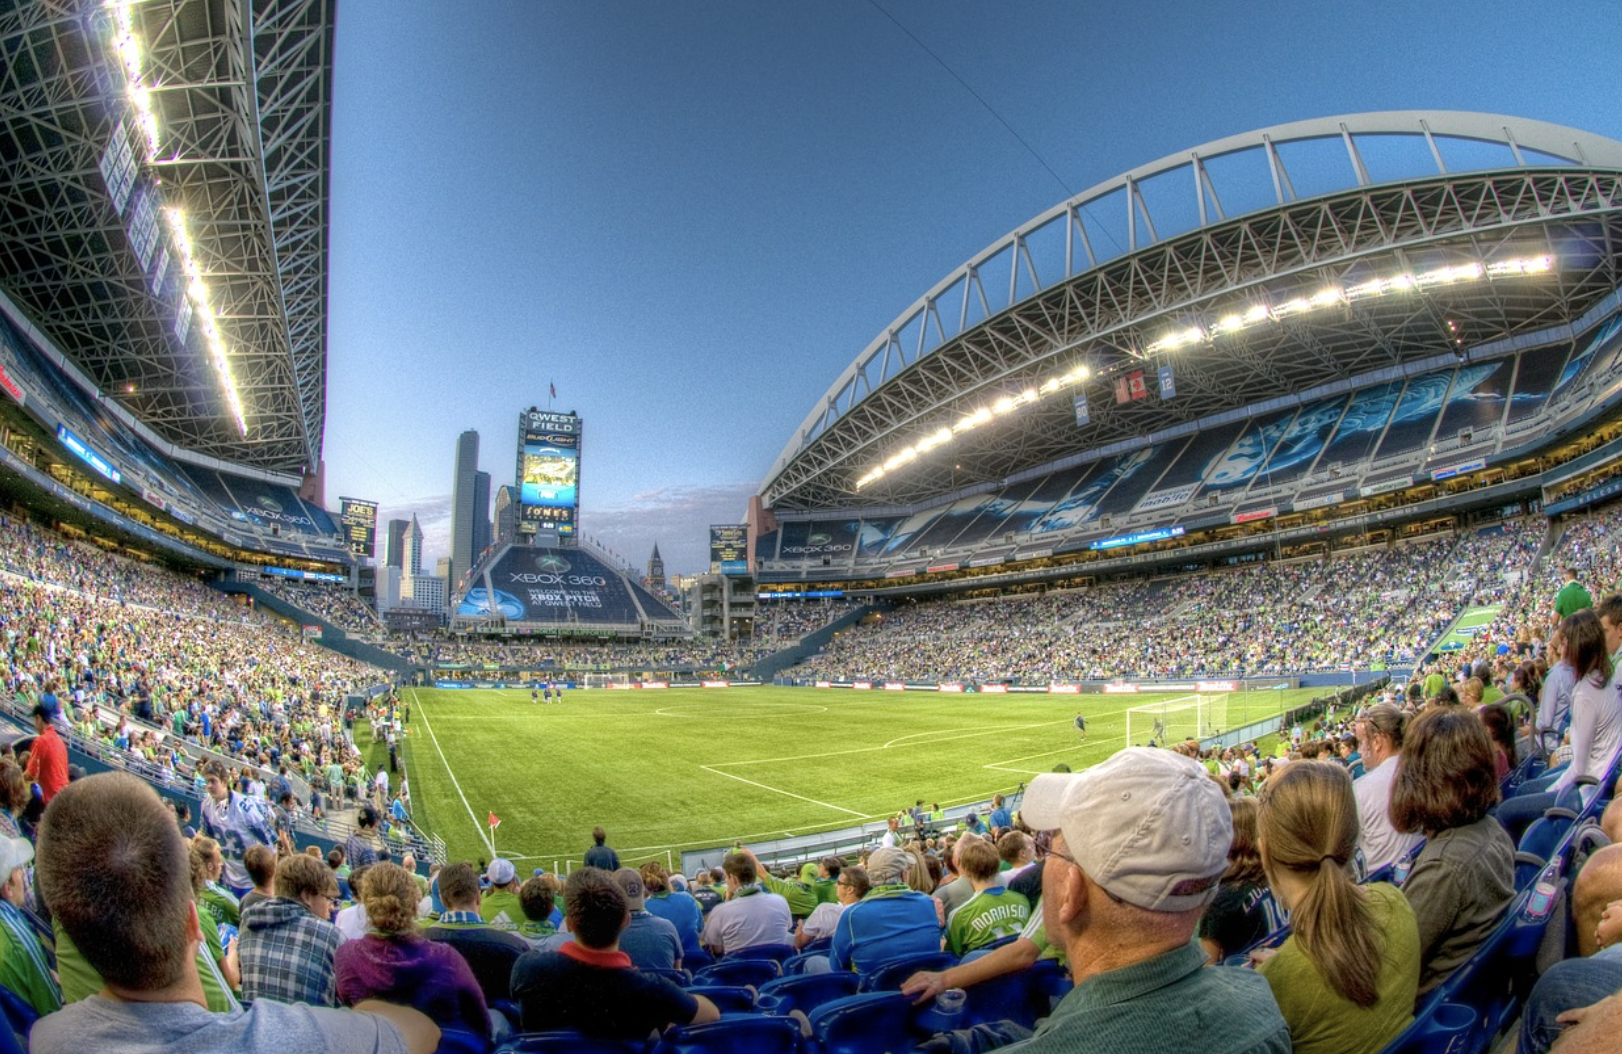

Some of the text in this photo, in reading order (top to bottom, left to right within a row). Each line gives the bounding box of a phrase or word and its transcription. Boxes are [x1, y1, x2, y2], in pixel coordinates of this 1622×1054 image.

[1161, 377, 1173, 391] 12
[529, 412, 576, 423] QWEST
[532, 421, 573, 431] FIELD
[549, 435, 576, 443] LIGHT
[1140, 493, 1189, 509] mobile
[782, 544, 852, 554] XBOX 360
[509, 572, 606, 586] XBOX 360
